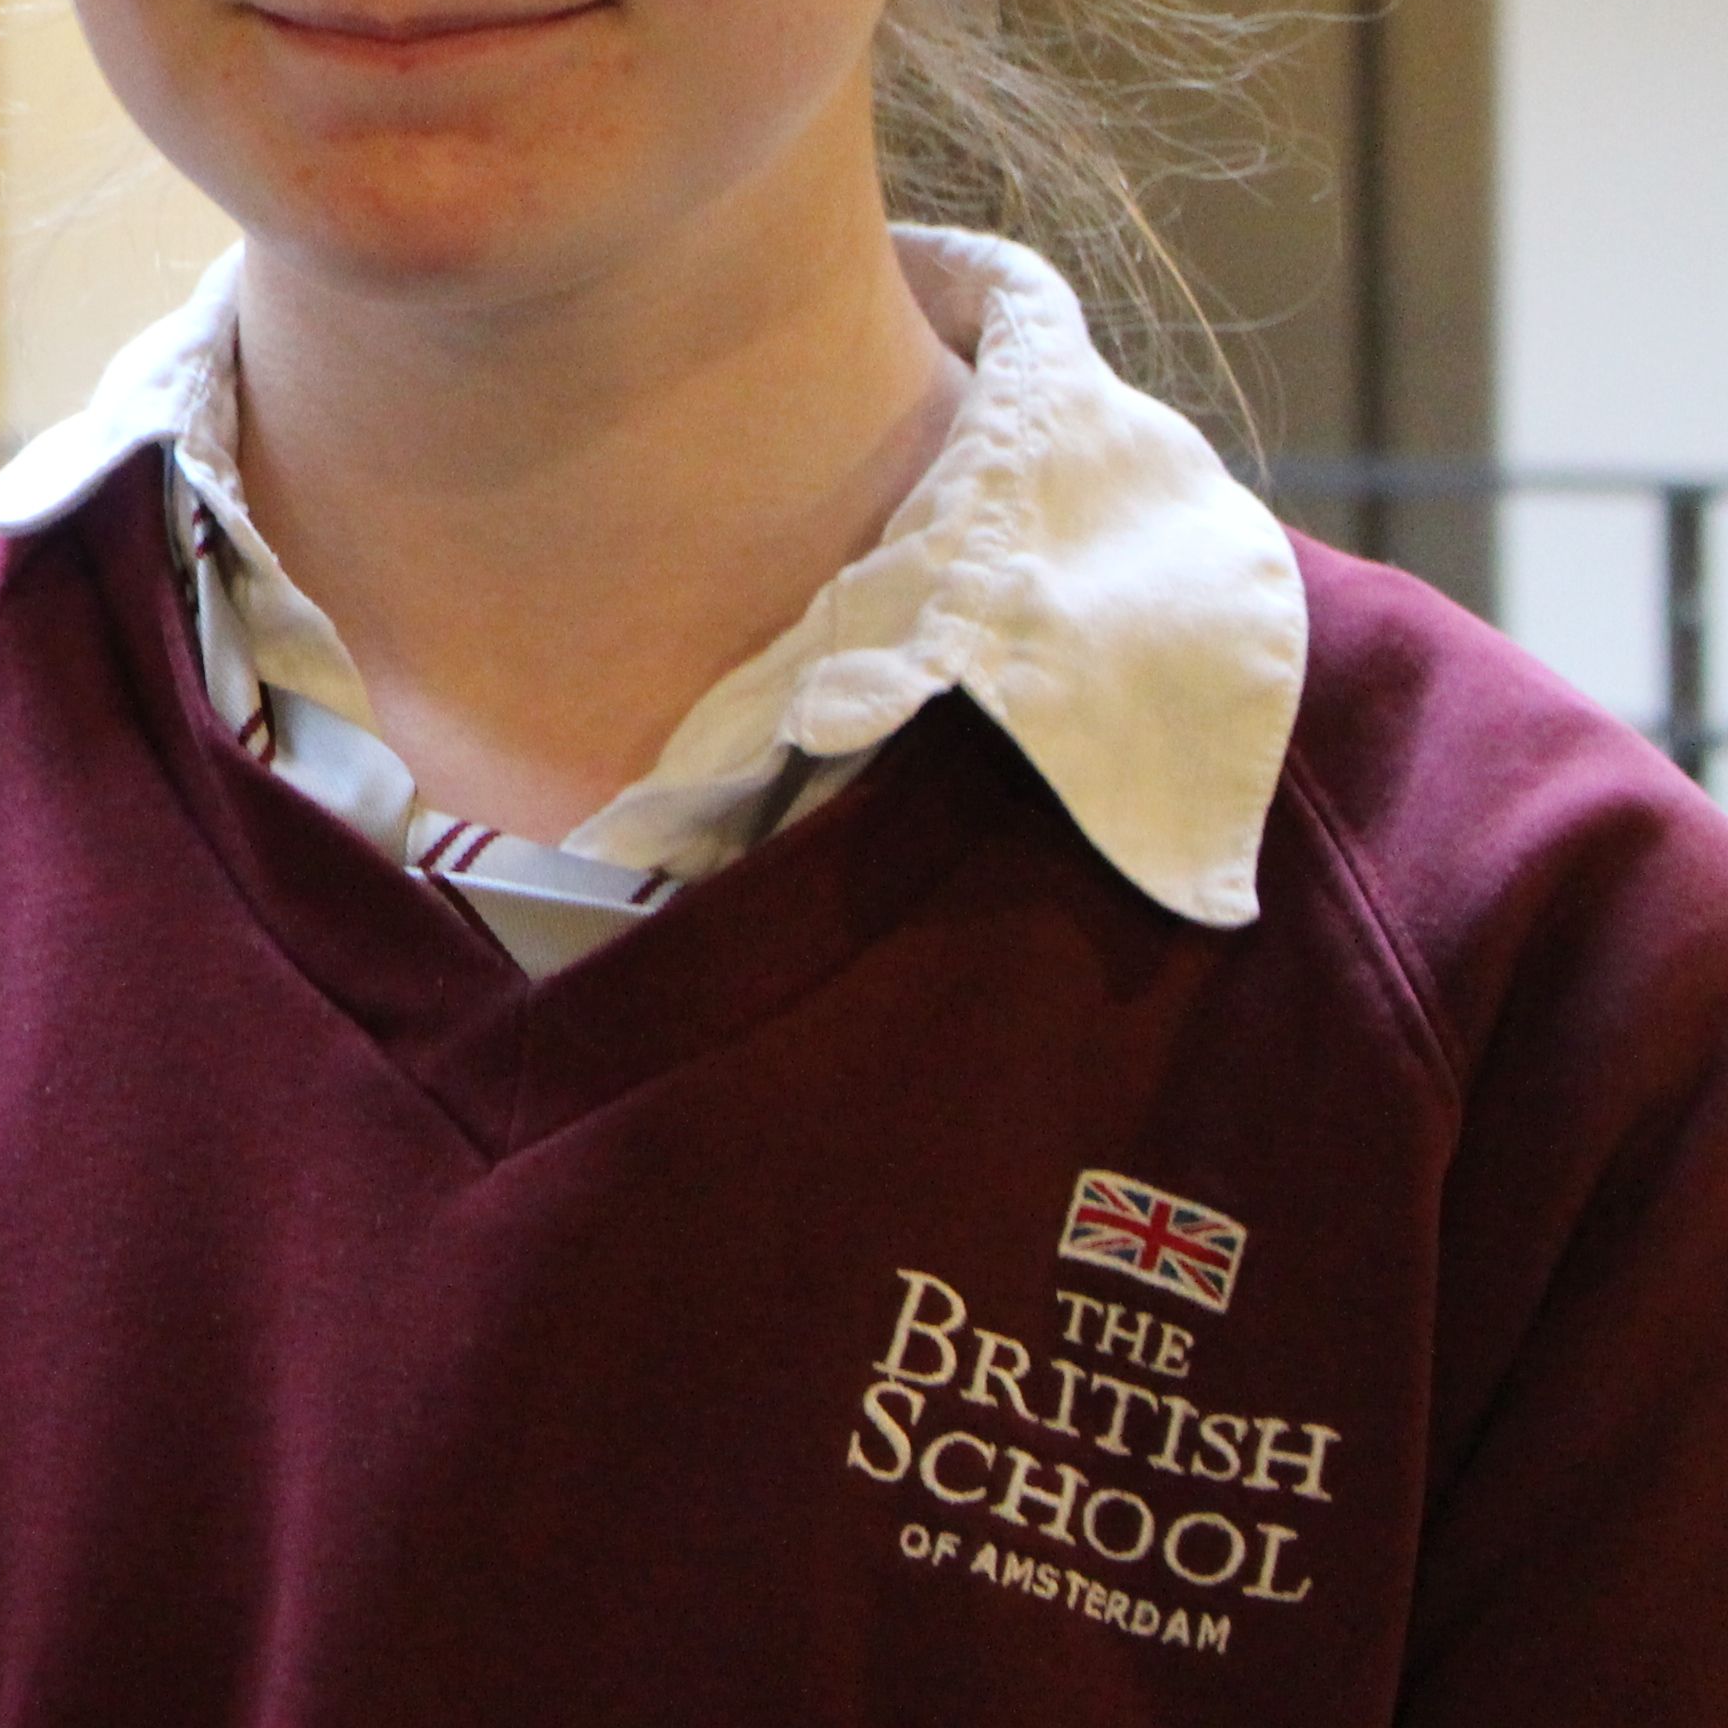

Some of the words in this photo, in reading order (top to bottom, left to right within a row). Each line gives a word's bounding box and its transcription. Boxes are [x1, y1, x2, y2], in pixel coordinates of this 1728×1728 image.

[871, 1268, 1342, 1502] BRITISH
[1056, 1290, 1196, 1378] THE
[846, 1380, 1312, 1603] SCHOOL
[899, 1523, 962, 1566] OF
[970, 1542, 1232, 1655] AMSTERDAM
